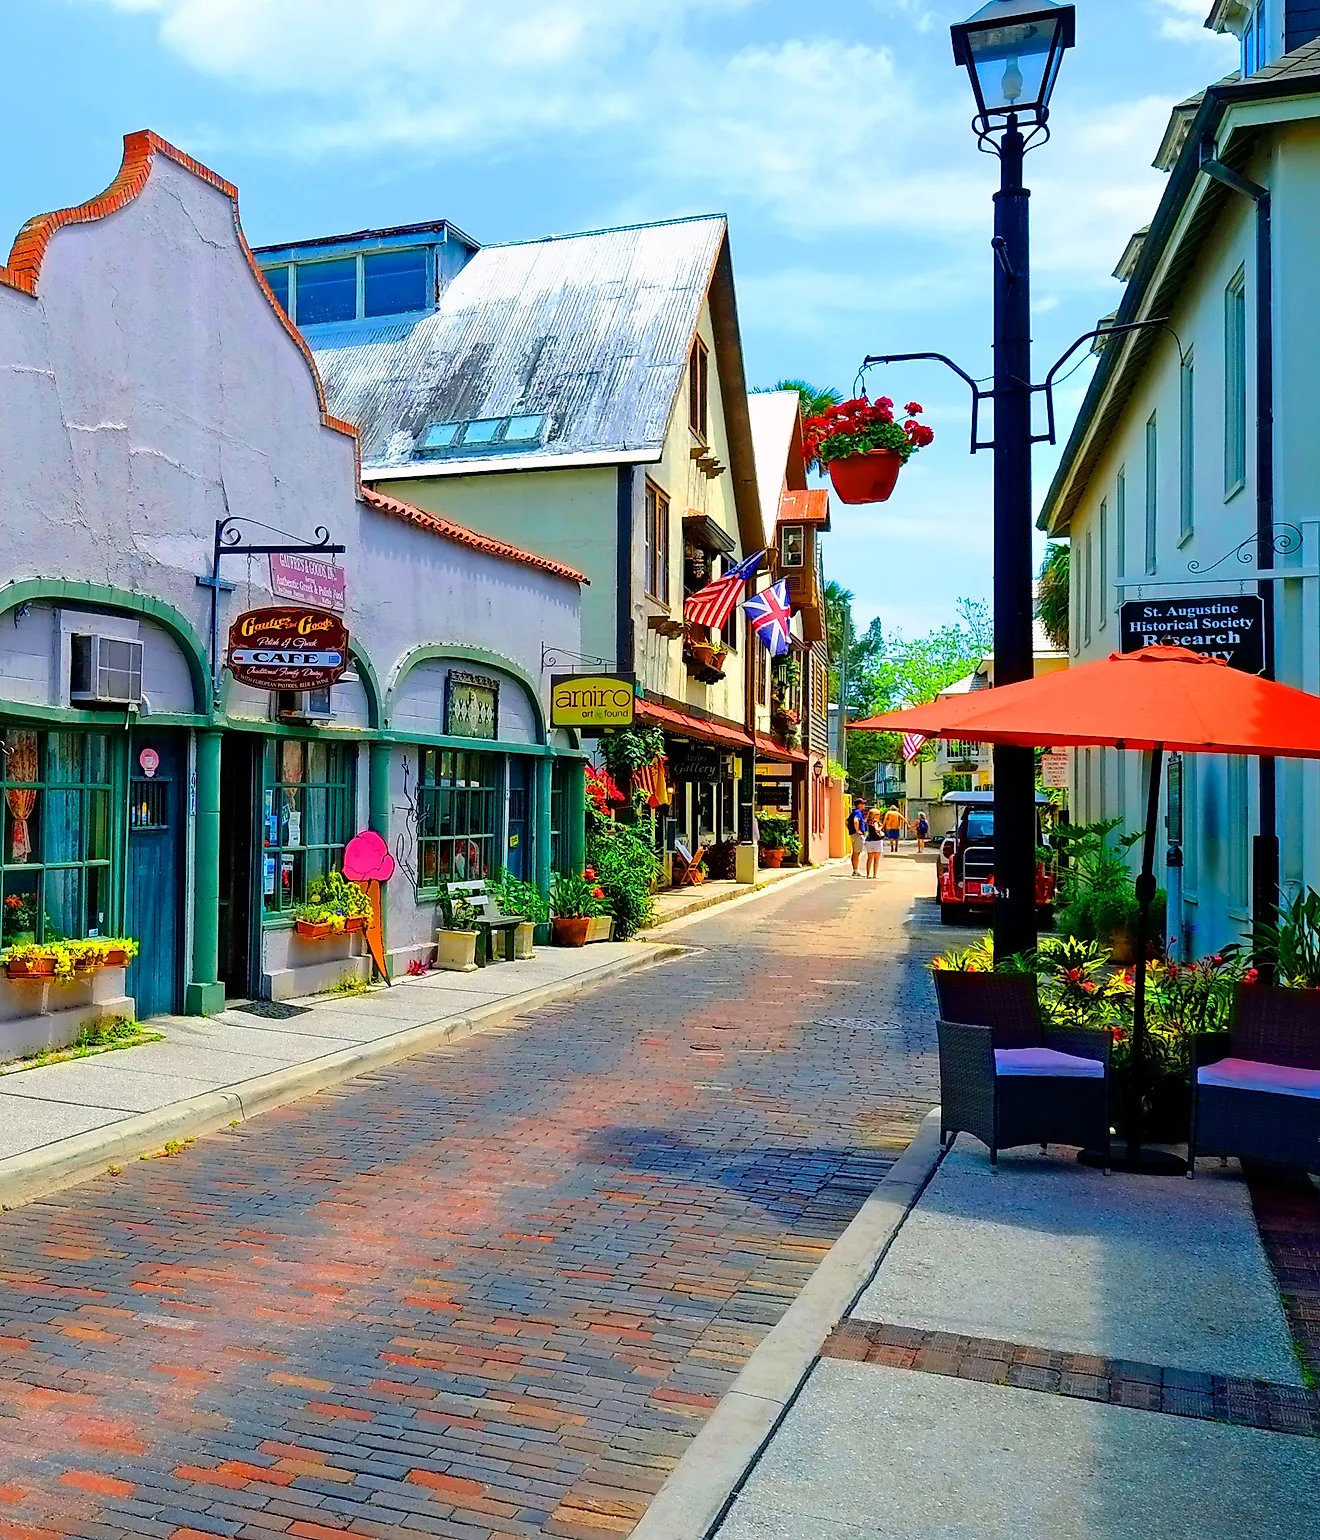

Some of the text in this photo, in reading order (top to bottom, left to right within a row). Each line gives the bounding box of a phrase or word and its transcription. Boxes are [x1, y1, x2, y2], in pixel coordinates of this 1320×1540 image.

[276, 574, 299, 589] Authentic
[299, 580, 314, 594] Greek
[314, 585, 319, 595] &
[319, 586, 333, 598] Polish
[333, 590, 343, 601] Food
[1143, 603, 1239, 618] St. Augustine
[298, 615, 334, 635] Goods
[1129, 617, 1254, 633] Historical Society
[256, 636, 280, 646] Polish
[292, 637, 318, 649] Greek
[1142, 631, 1241, 647] Rsearch
[252, 652, 320, 664] CAFE
[246, 666, 324, 679] Traditional Family Dining
[240, 674, 253, 683] WITH
[252, 678, 277, 688] EUROPEAN
[315, 678, 330, 686] WINE
[555, 686, 631, 708] amiro
[581, 710, 593, 718] art
[604, 709, 629, 718] found
[674, 762, 716, 777] Gallery
